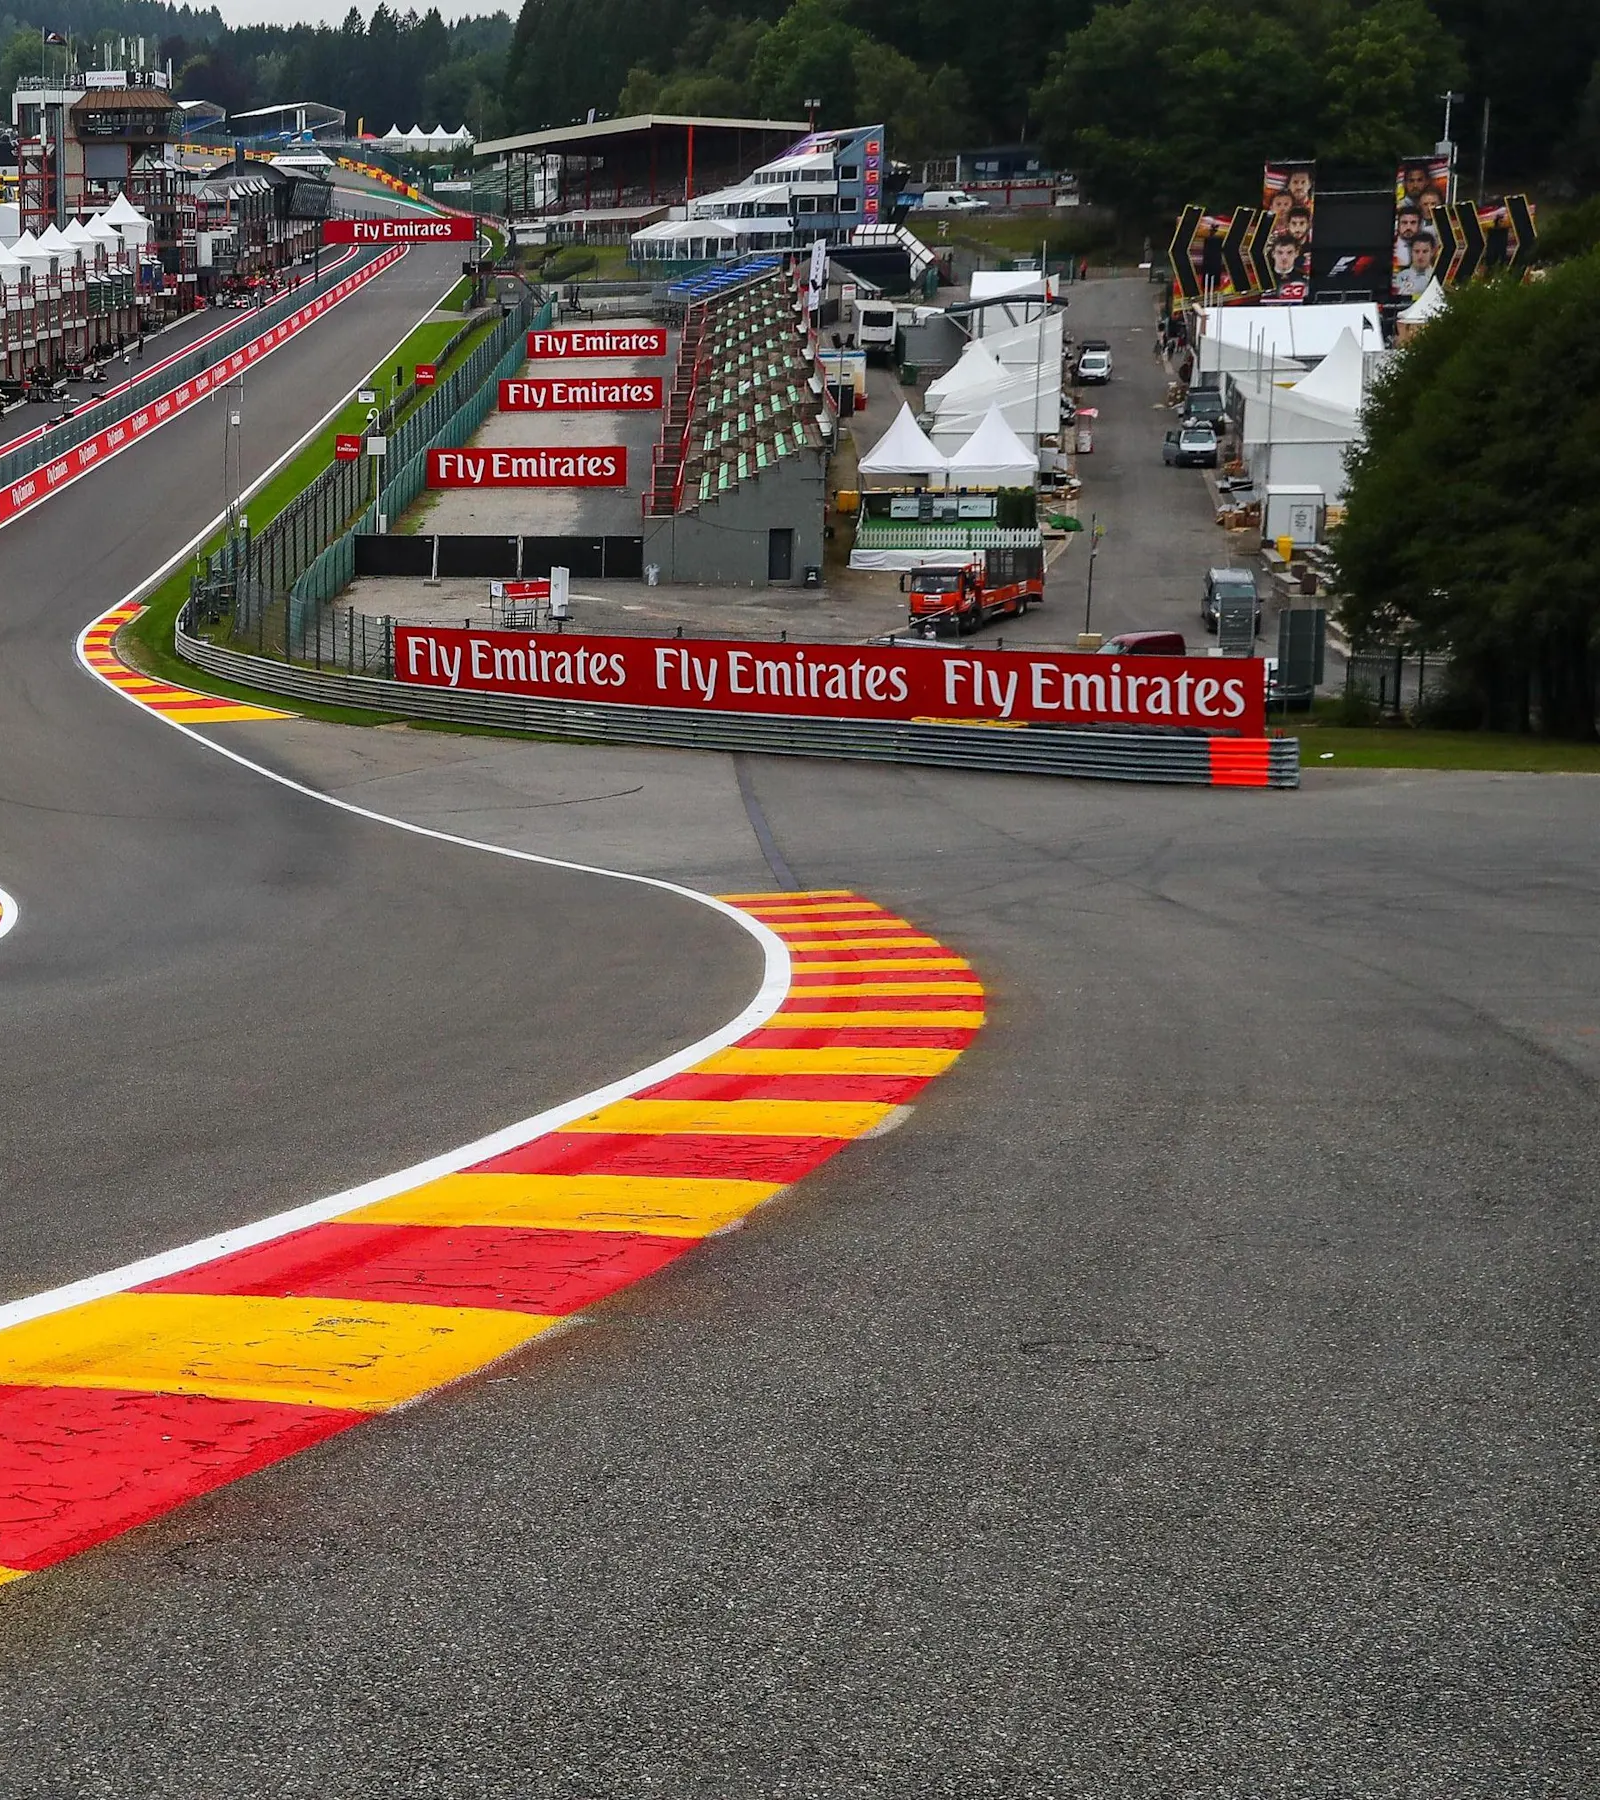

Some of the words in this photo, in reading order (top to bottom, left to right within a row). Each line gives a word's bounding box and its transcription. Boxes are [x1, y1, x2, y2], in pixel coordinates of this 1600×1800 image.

[135, 73, 155, 84] 9:17
[353, 223, 379, 240] Fly
[383, 221, 451, 237] Emirates
[534, 334, 567, 356] Fly
[572, 331, 659, 352] Emirates
[508, 383, 546, 408] Fly
[552, 380, 654, 404] Emirates
[438, 454, 485, 484] Fly
[492, 452, 616, 479] Emirates
[407, 636, 461, 687] Fly
[468, 640, 626, 687] Emirates
[655, 648, 717, 701] Fly
[727, 651, 908, 702] Emirates
[944, 659, 1018, 718] Fly
[1030, 663, 1246, 718] Emirates
